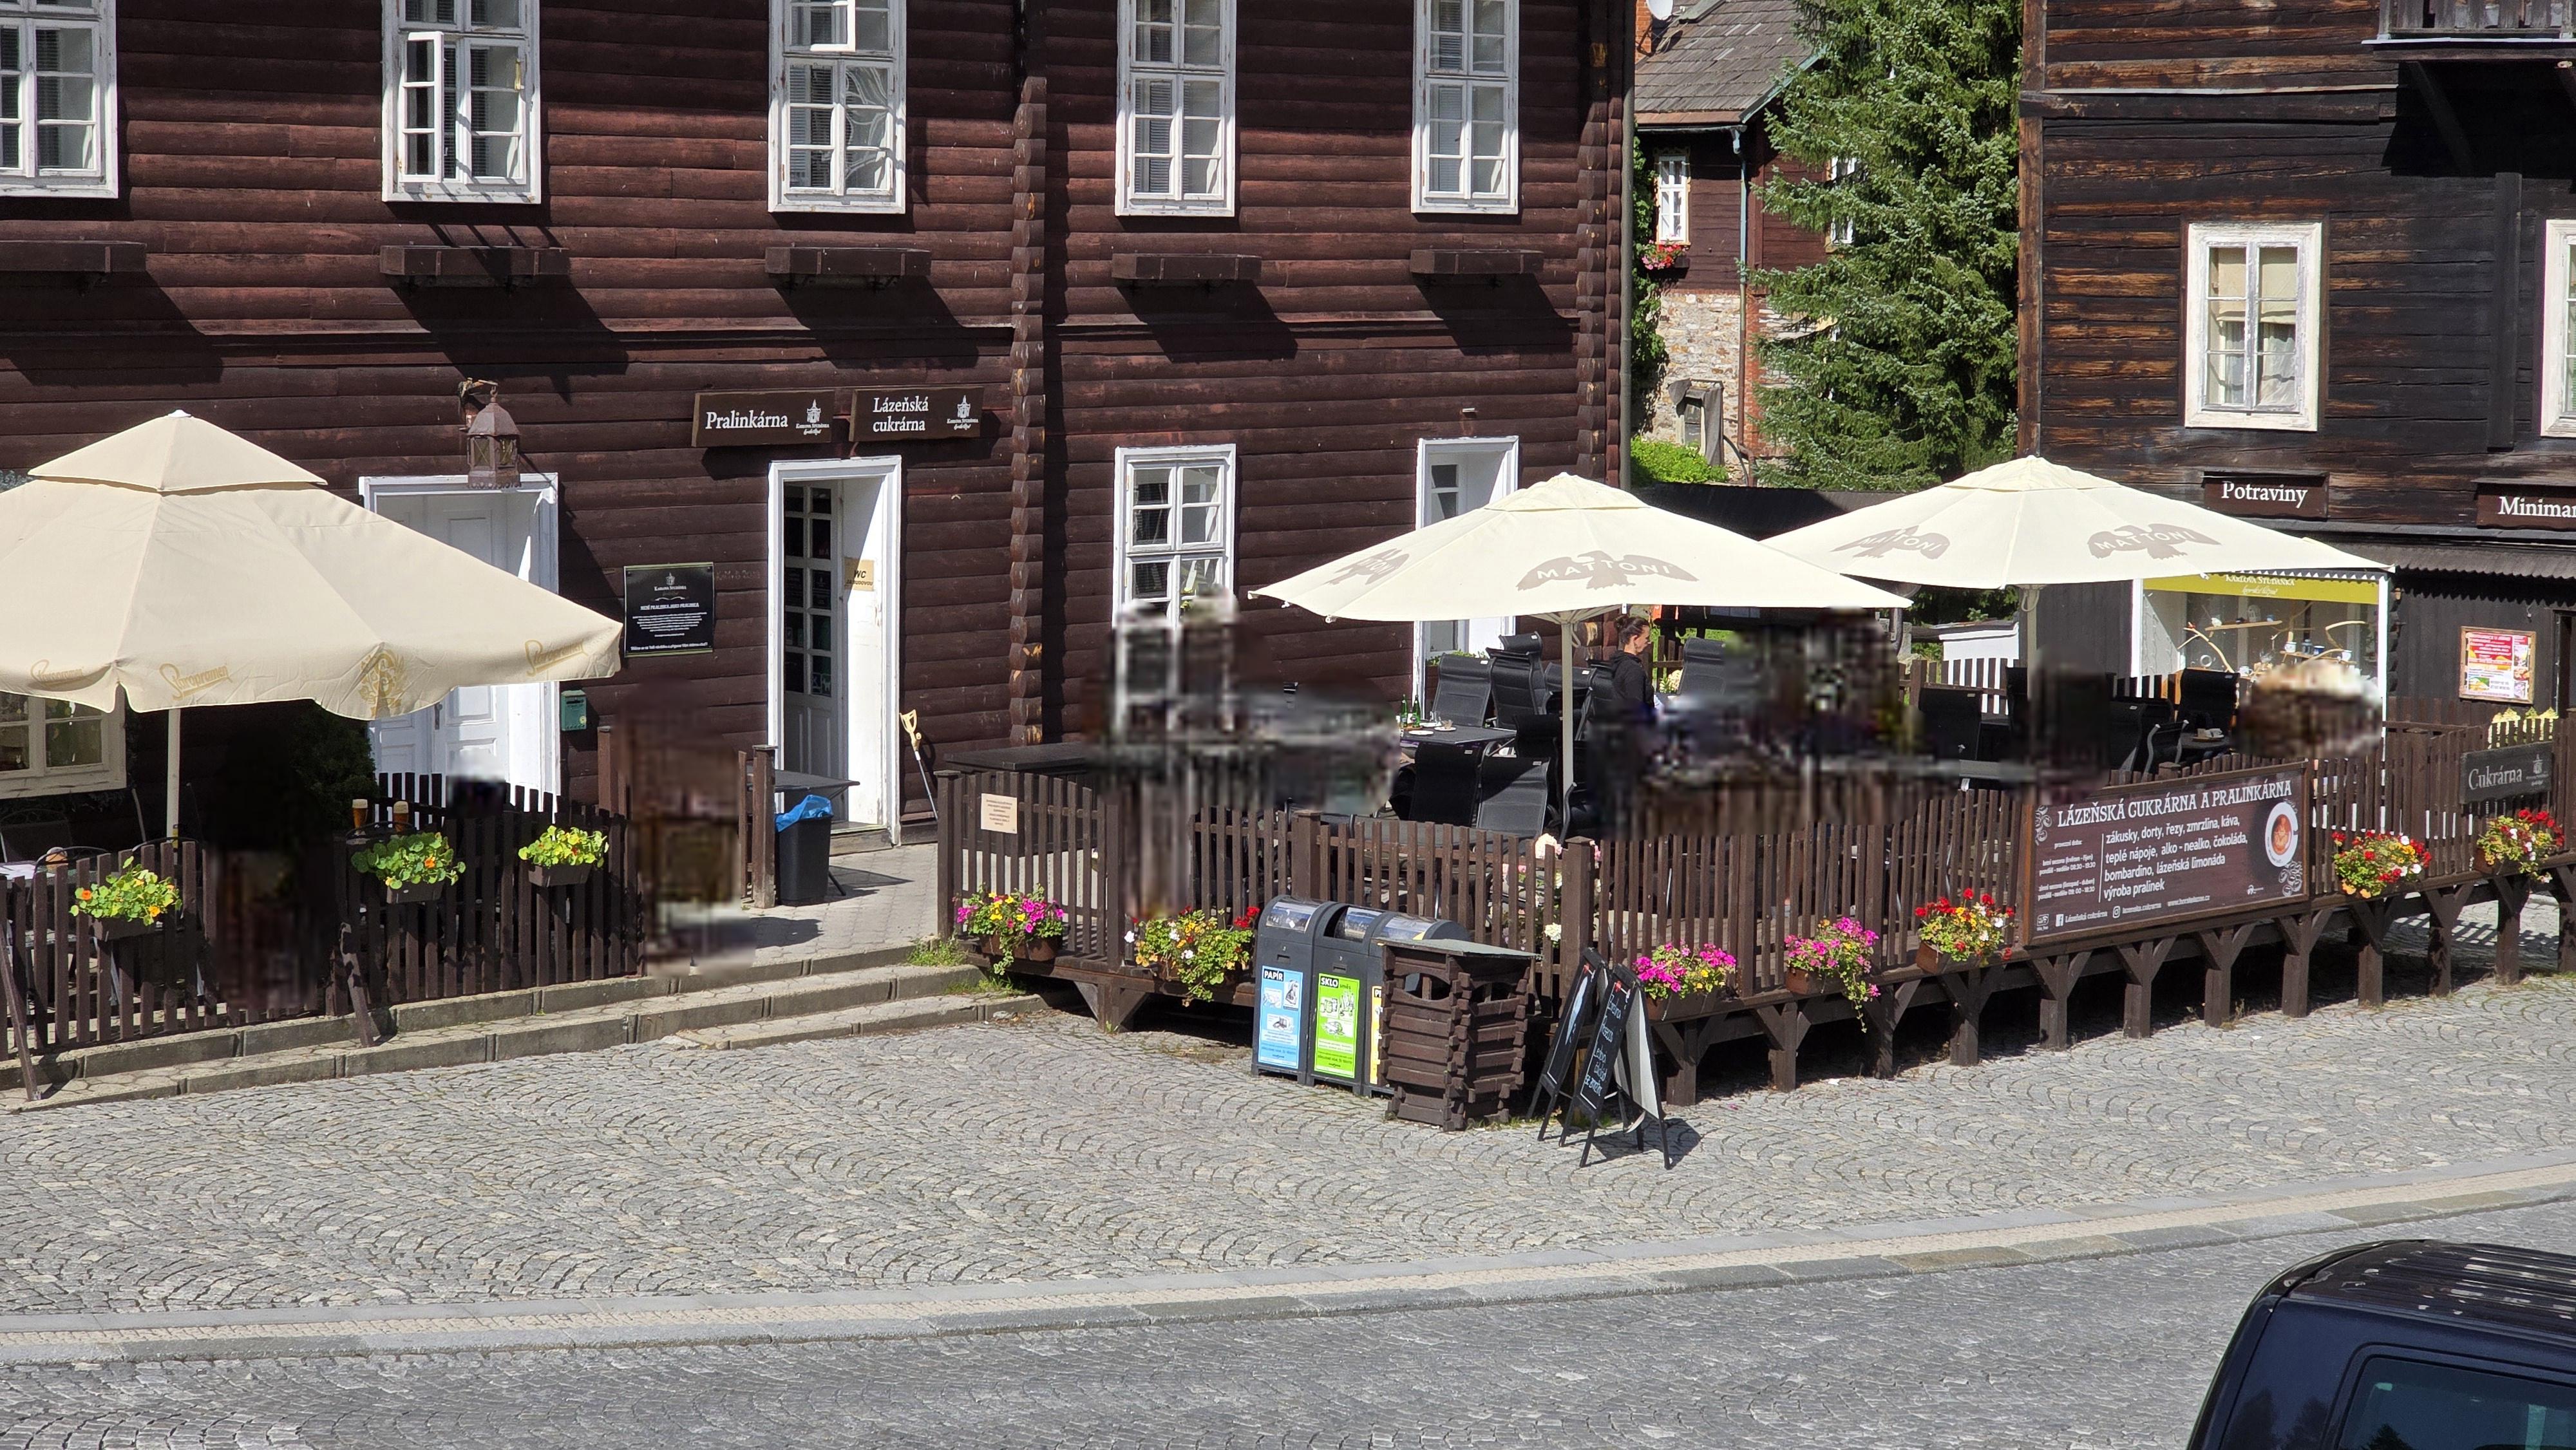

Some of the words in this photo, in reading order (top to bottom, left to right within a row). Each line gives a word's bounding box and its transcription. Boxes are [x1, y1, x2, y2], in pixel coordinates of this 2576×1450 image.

[873, 395, 929, 413] Lázeňská
[705, 410, 789, 429] Pralinkárna
[873, 416, 925, 432] cukrárna
[2221, 480, 2308, 509] Potraviny
[1859, 529, 1942, 551] MATTONI
[2094, 530, 2197, 551] MATTONI
[854, 570, 867, 579] WC
[1537, 561, 1670, 580] MATTONI
[159, 663, 232, 701] Staropramen
[2468, 765, 2523, 790] Cukrárna
[2058, 798, 2126, 827] LÁZEŇSKÁ
[2128, 791, 2197, 819] CUKRÁRNA
[2200, 792, 2210, 809] A
[2211, 778, 2293, 807] PRALINKÁRNA
[2105, 828, 2140, 844] zákusky,
[2141, 825, 2164, 840] dorty,
[2166, 822, 2186, 836] řezy,
[2186, 817, 2220, 832] zmrzlina,
[2221, 814, 2240, 827] káva,
[2105, 849, 2128, 865] teplé
[2129, 844, 2158, 862] nápoje,
[2161, 842, 2177, 856] alko
[2184, 838, 2211, 852] nealko,
[2213, 831, 2248, 848] čokoláda,
[2104, 865, 2154, 882] bombardino,
[2156, 857, 2190, 874] lázeňská
[2191, 852, 2226, 869] limonáda
[2103, 881, 2132, 901] výroba
[2133, 878, 2165, 898] pralinek
[1264, 970, 1283, 981] PAPÍR
[1320, 977, 1339, 988] SKLO
